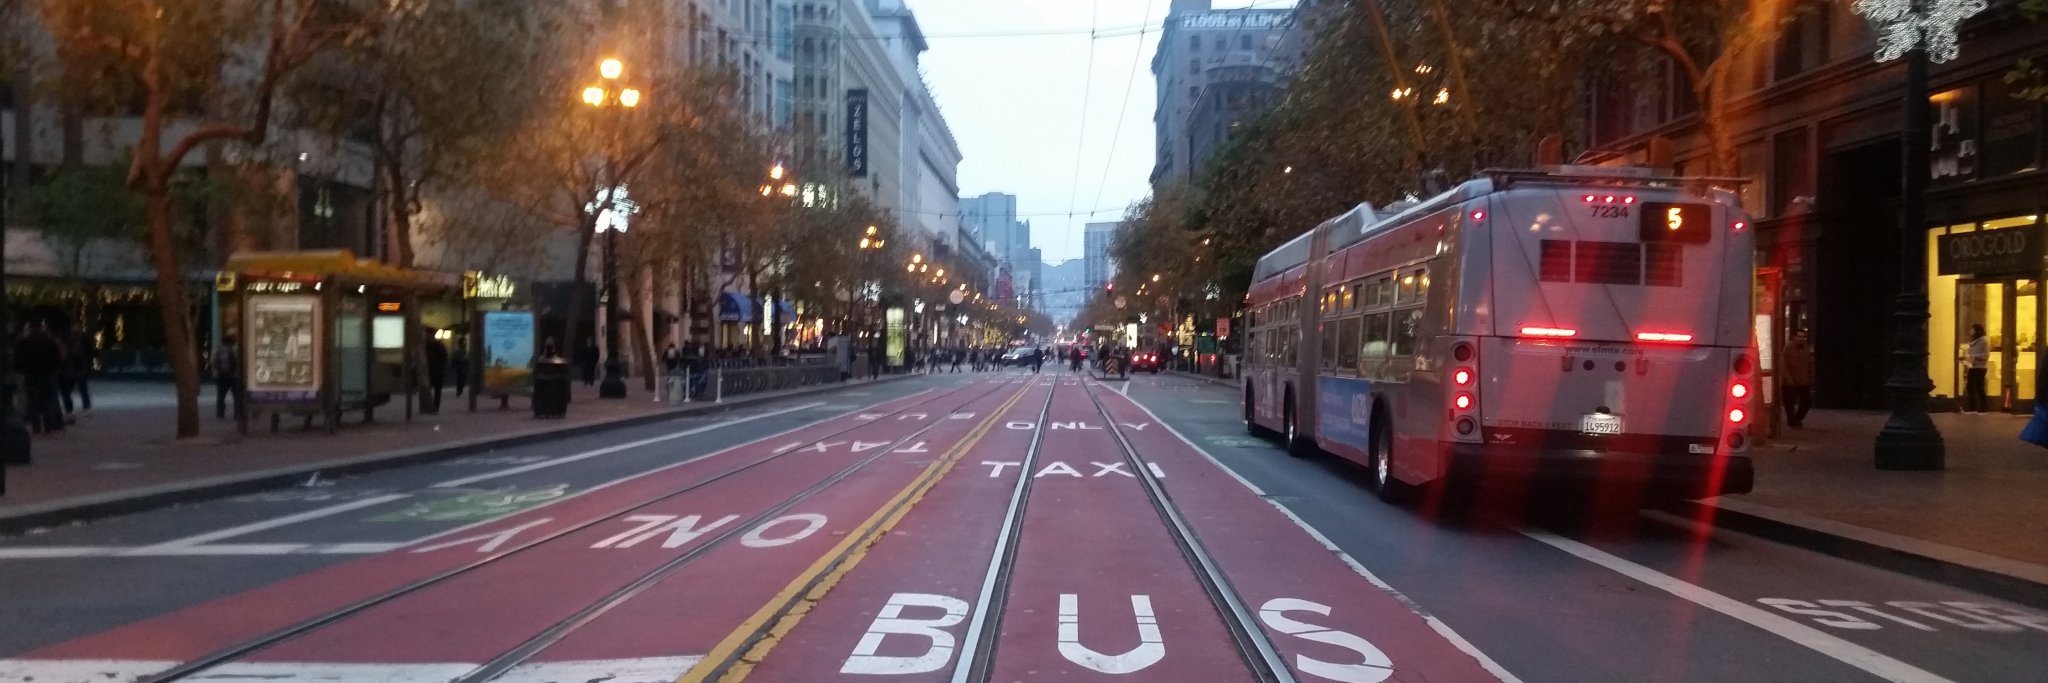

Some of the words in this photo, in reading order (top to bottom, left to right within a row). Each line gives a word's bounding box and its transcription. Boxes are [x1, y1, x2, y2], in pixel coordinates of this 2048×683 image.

[1183, 13, 1226, 28] FLOOD
[853, 103, 862, 170] ZELOS
[1591, 205, 1630, 219] 7234
[1667, 207, 1682, 231] 5
[1950, 231, 2026, 258] OROGOLD
[1006, 421, 1150, 431] ONLY
[1585, 421, 1619, 433] 1495912
[981, 460, 1166, 478] TAXI
[409, 513, 828, 553] ONLY
[839, 593, 1395, 683] BUS
